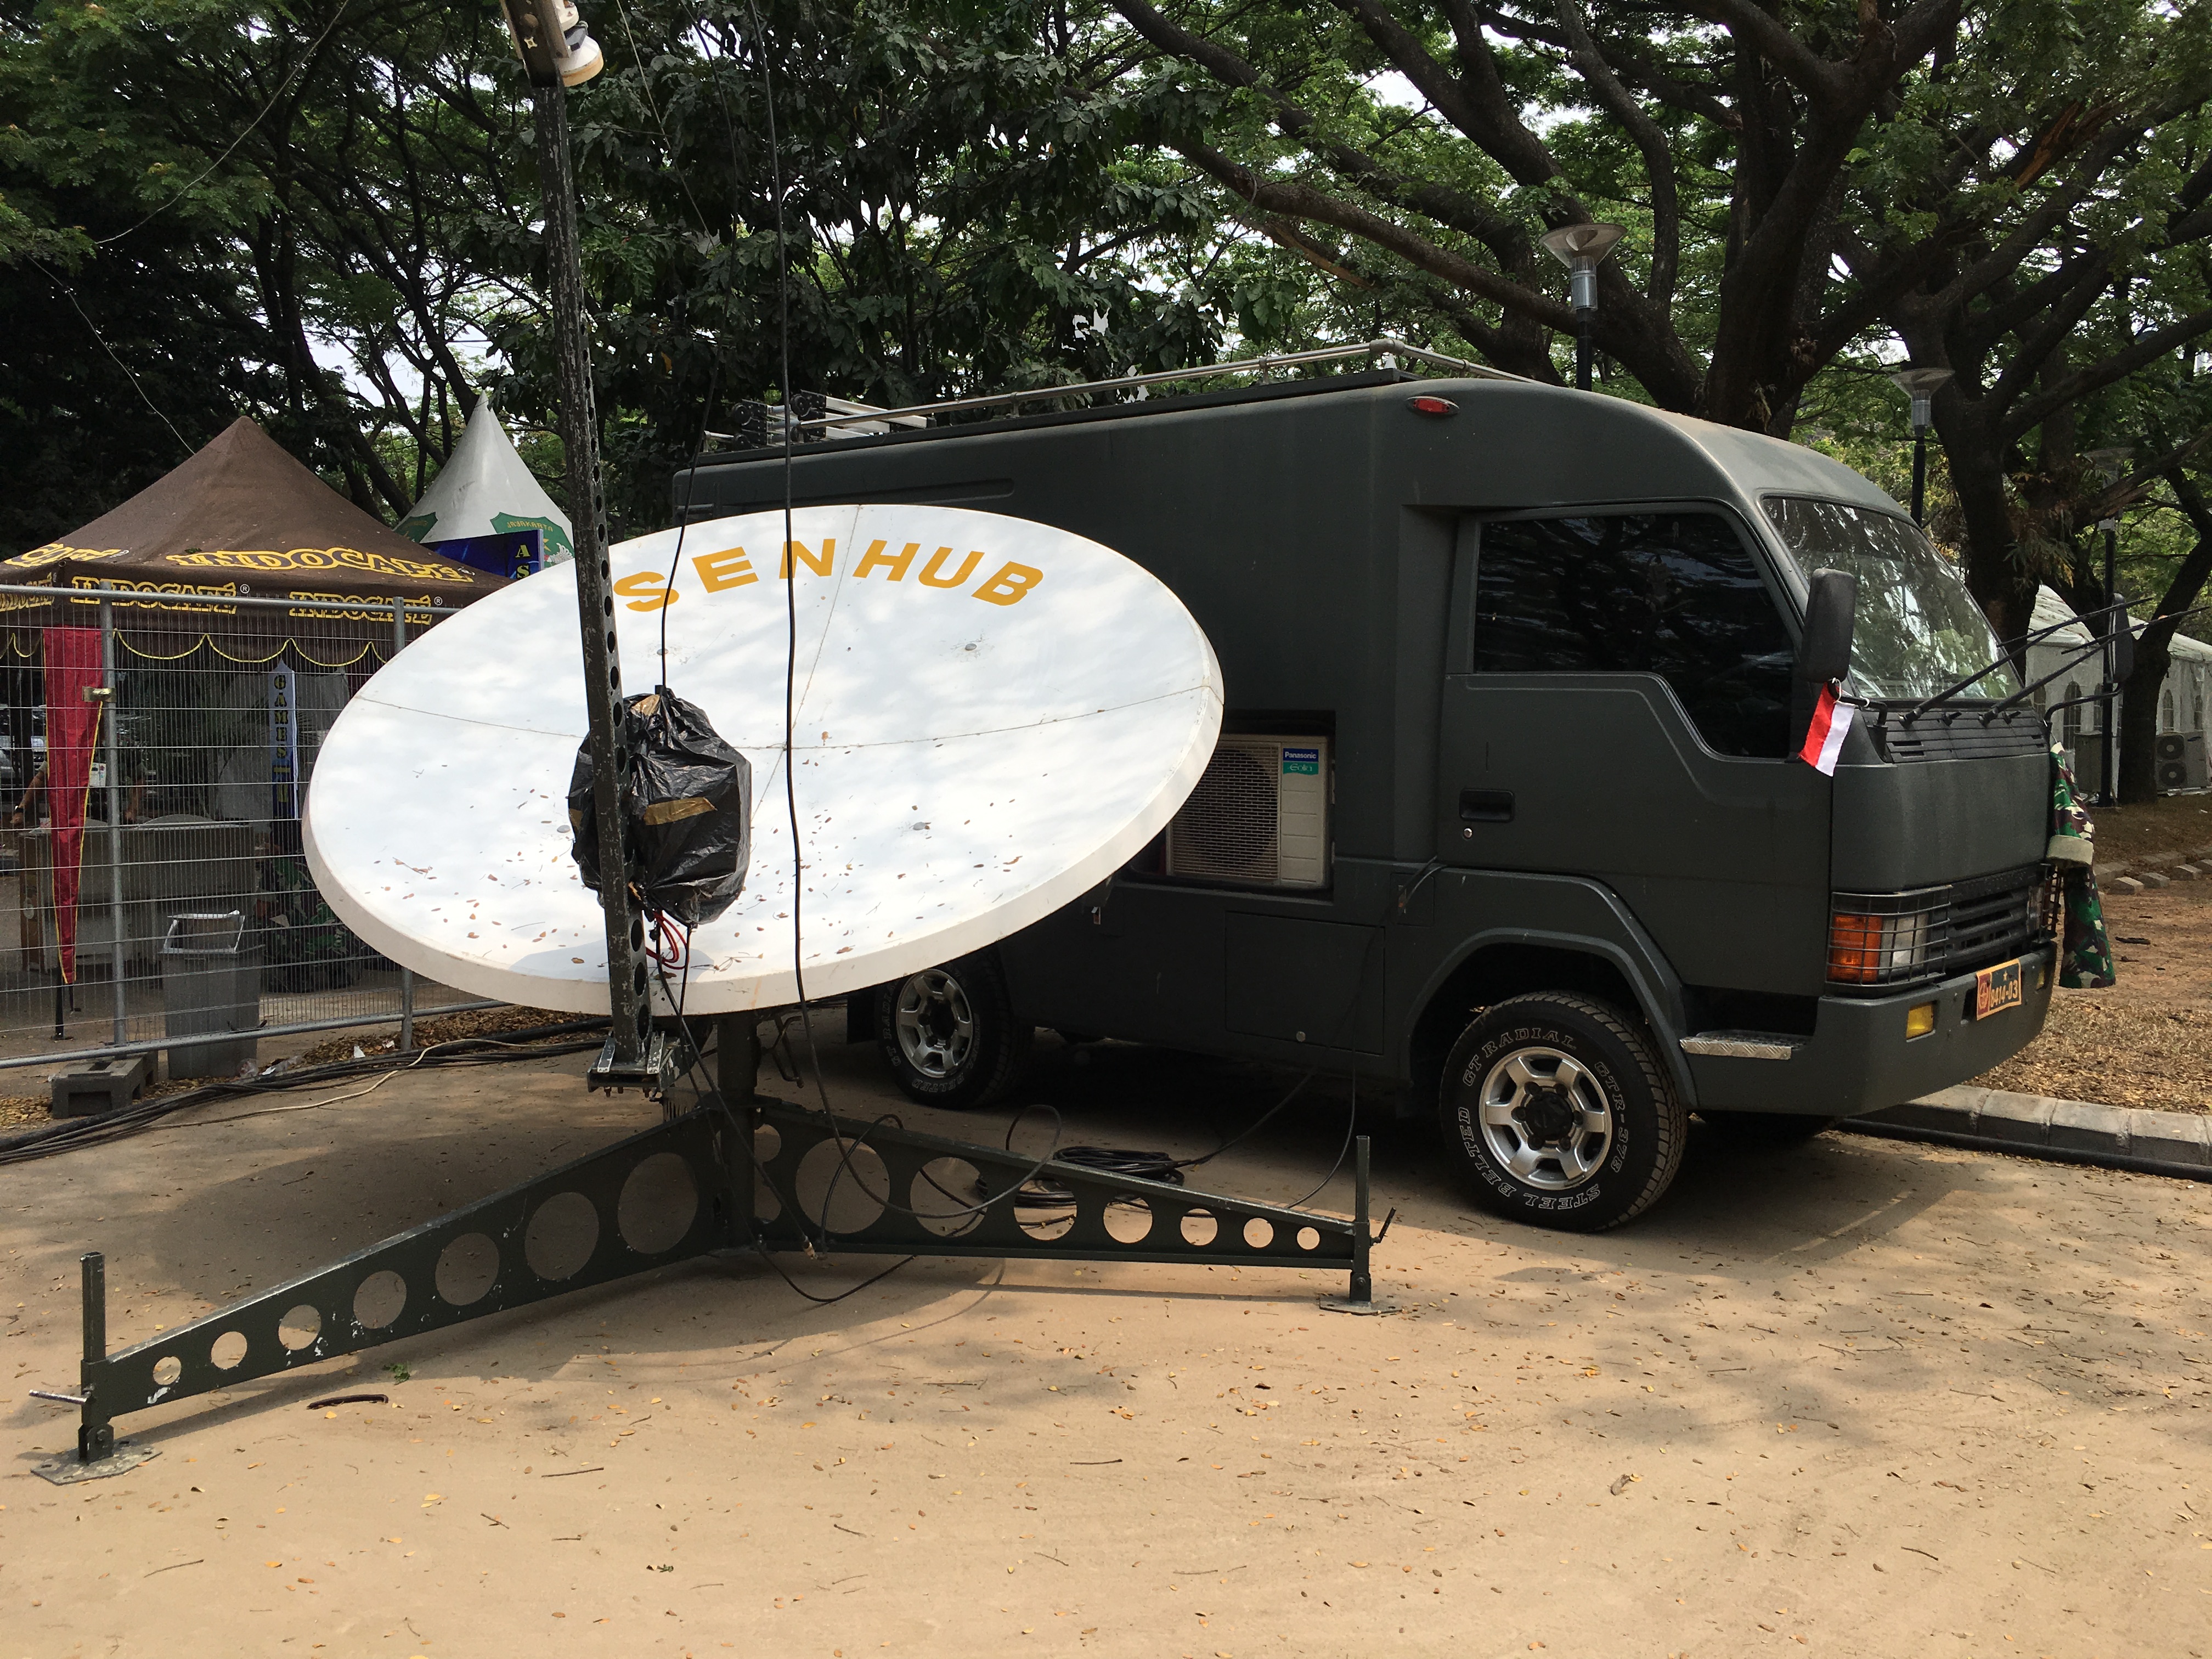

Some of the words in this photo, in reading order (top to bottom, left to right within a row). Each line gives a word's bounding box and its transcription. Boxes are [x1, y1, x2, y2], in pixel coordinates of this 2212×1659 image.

[613, 538, 1044, 612] SENHUB
[1285, 751, 1317, 759] Panasonic
[1462, 1054, 1483, 1087] GT
[1482, 1027, 1577, 1059] RADIAL
[1594, 1060, 1629, 1173] GTR-378
[1457, 1106, 1517, 1198] BELTED
[1523, 1183, 1601, 1210] STEEL
